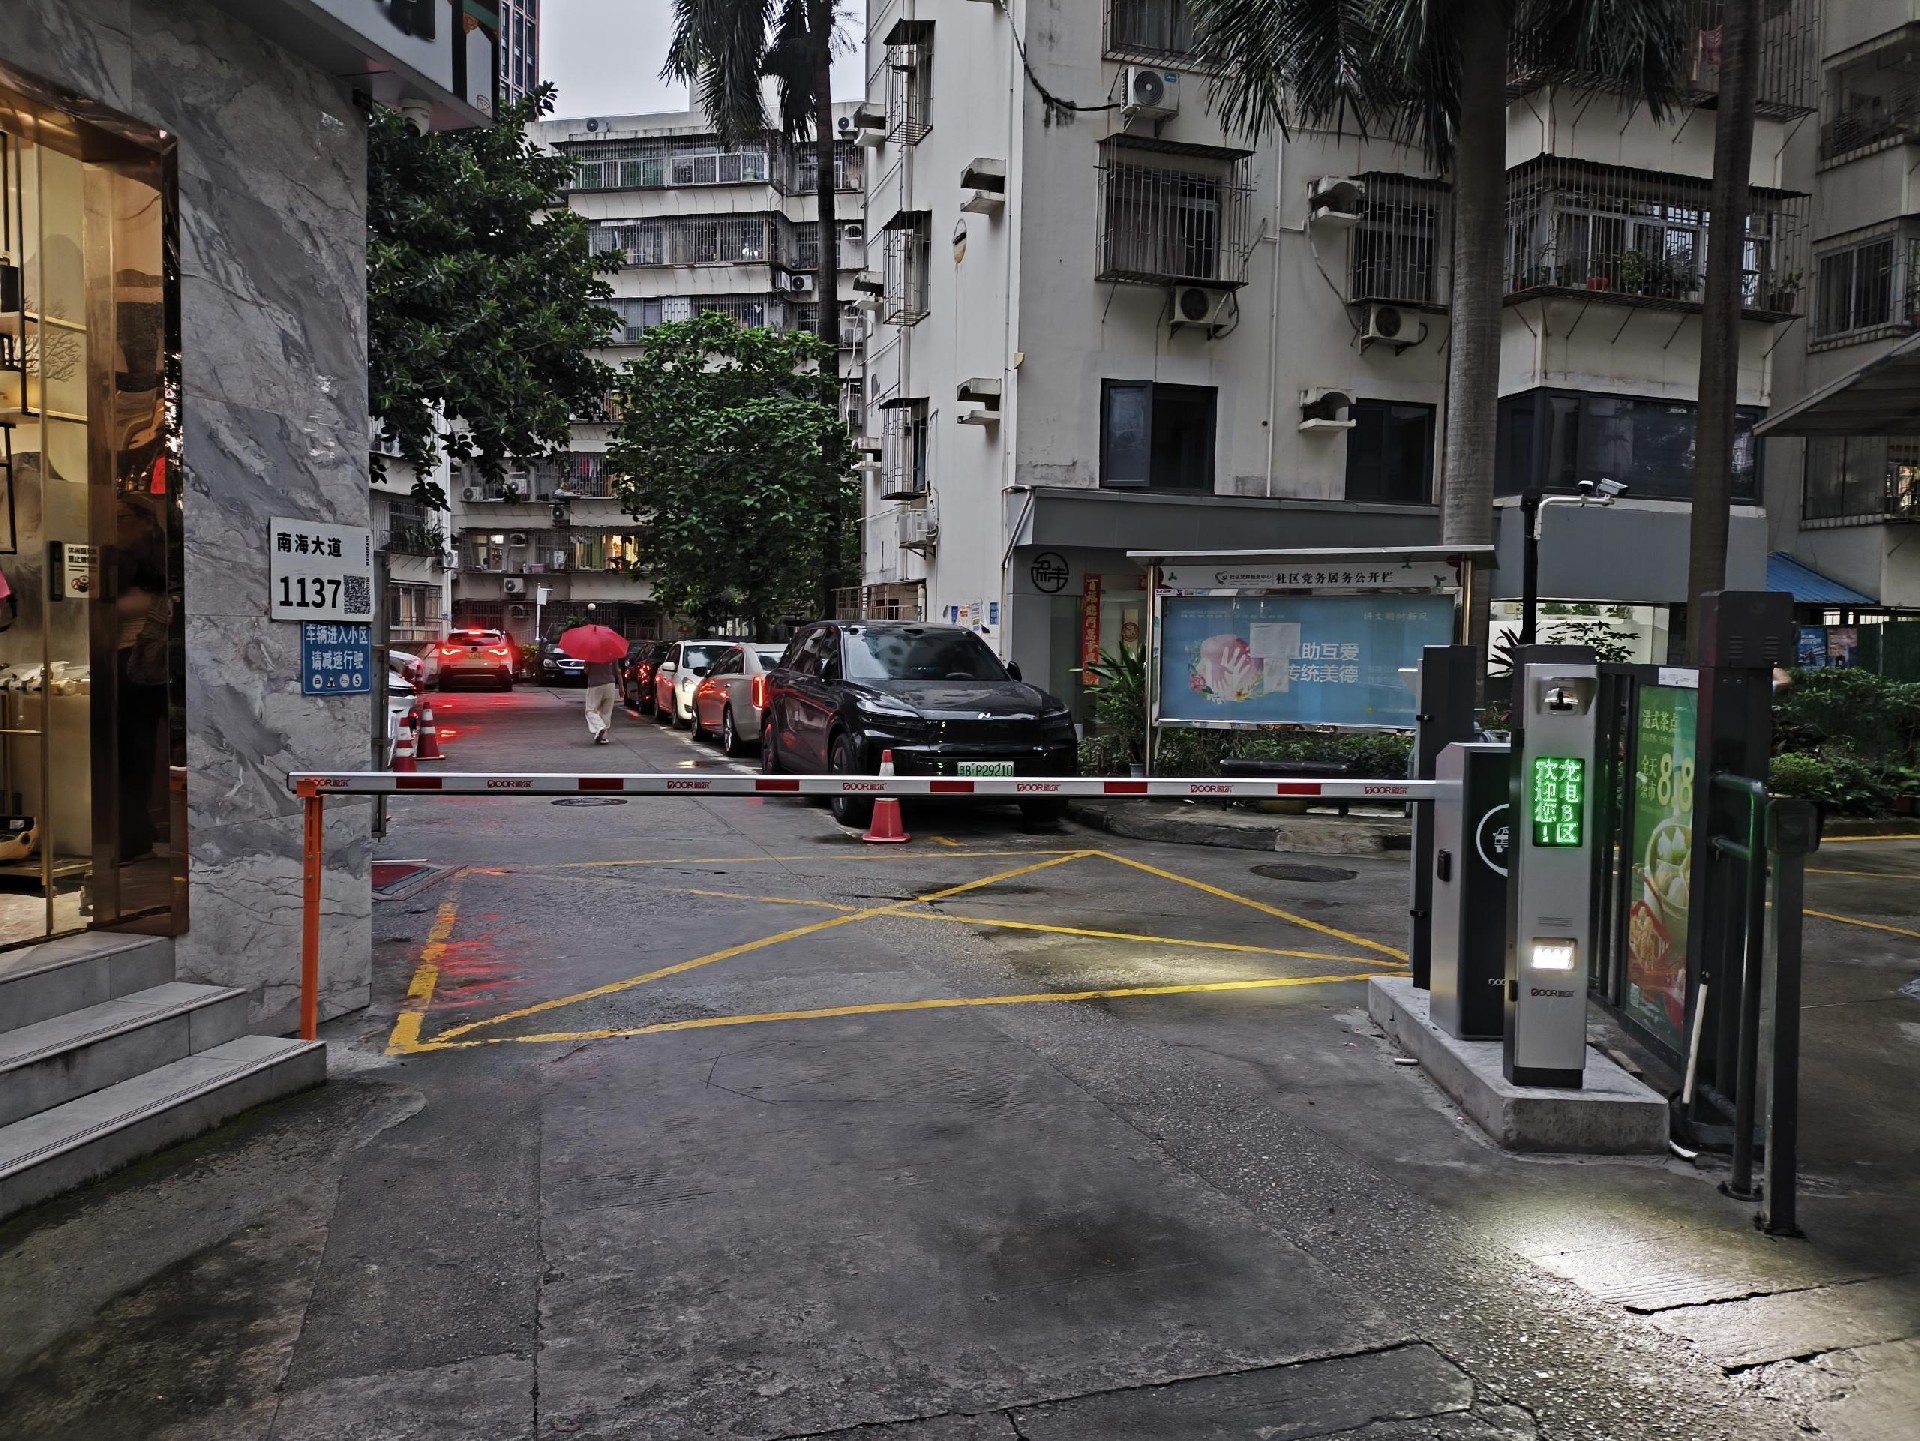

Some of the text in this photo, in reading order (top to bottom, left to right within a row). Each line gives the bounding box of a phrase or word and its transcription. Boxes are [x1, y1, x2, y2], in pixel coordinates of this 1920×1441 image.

[277, 532, 342, 558] 南海大道
[1276, 571, 1393, 585] 社区党务居务公开栏
[279, 576, 342, 609] 1137
[304, 624, 369, 645] 车辆进入小区
[311, 650, 364, 670] 请减速行驶
[1290, 641, 1360, 662] 助互爱
